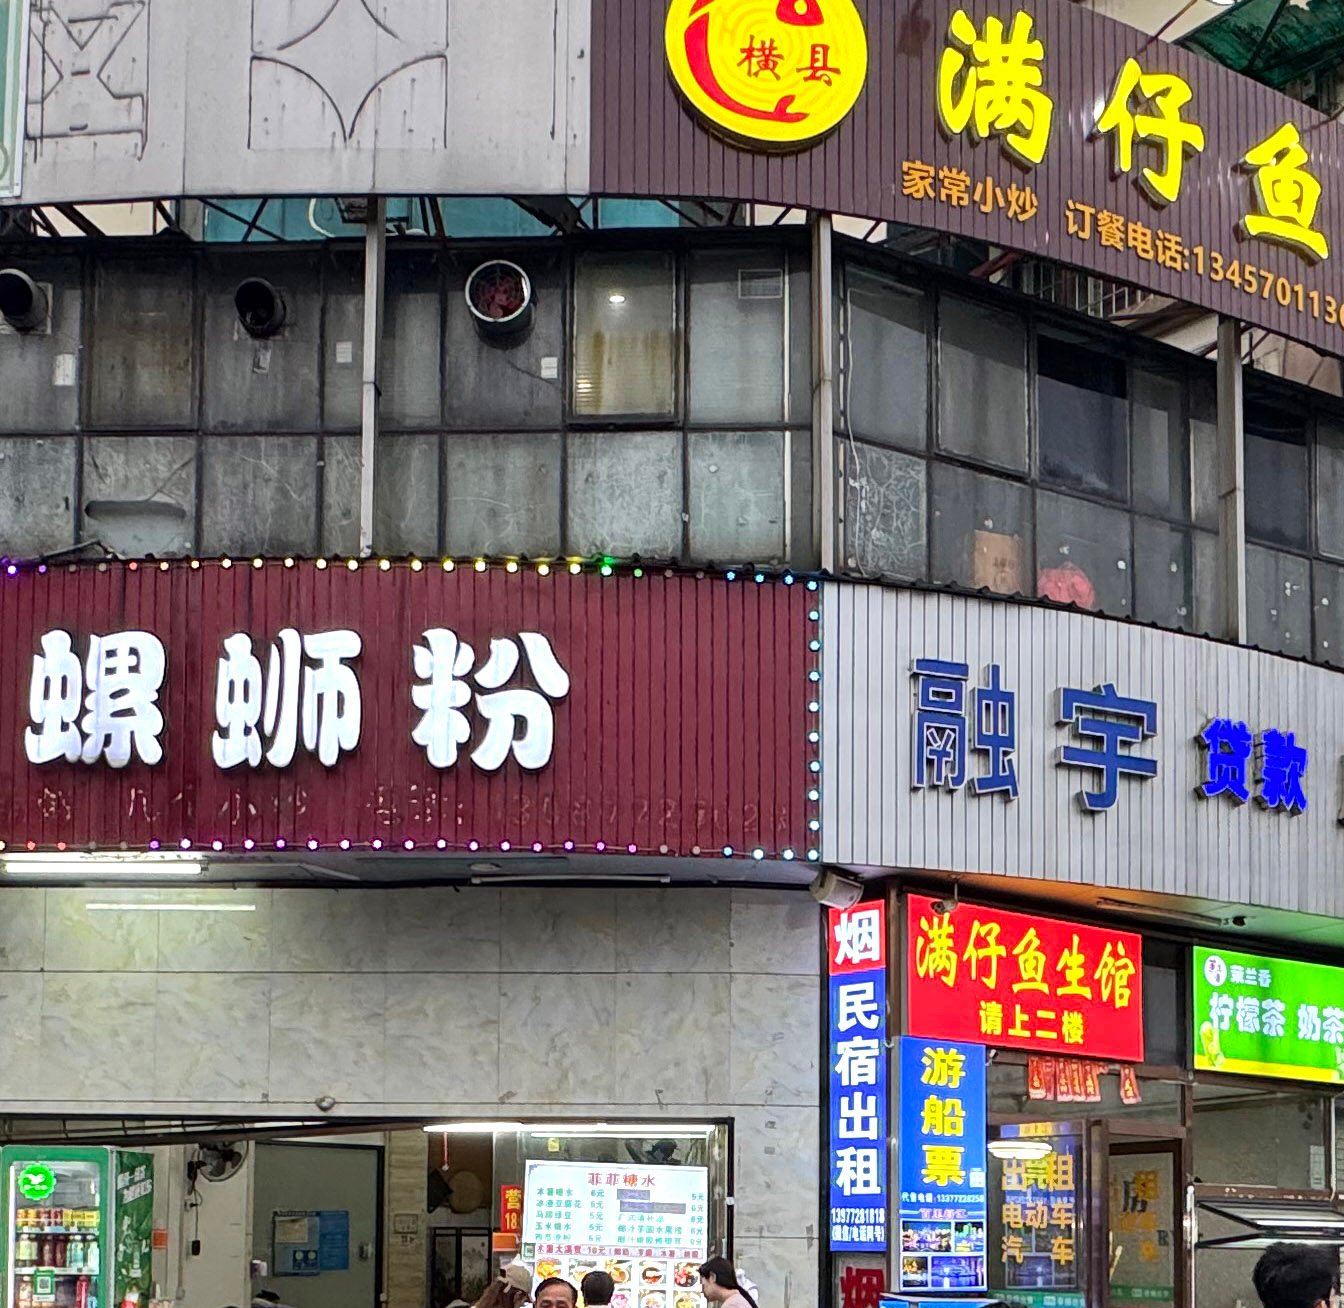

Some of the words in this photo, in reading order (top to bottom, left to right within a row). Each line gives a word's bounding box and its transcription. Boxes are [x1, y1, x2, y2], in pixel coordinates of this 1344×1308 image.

[737, 34, 841, 85] 横县
[901, 160, 1038, 223] 家常小炒
[911, 658, 1158, 812] 融宇
[1200, 717, 1309, 813] 贷款
[835, 908, 881, 966] 烟
[916, 911, 1137, 1010] 满仔鱼生馆
[979, 1000, 1086, 1046] 请上二楼
[1209, 990, 1287, 1038] 柠檬茶
[1297, 1003, 1344, 1045] 奶茶
[835, 981, 881, 1196] 民宿出租
[921, 1046, 966, 1188] 游船票
[588, 1172, 656, 1187] 菲菲糖水
[1002, 1200, 1075, 1230] 电动车
